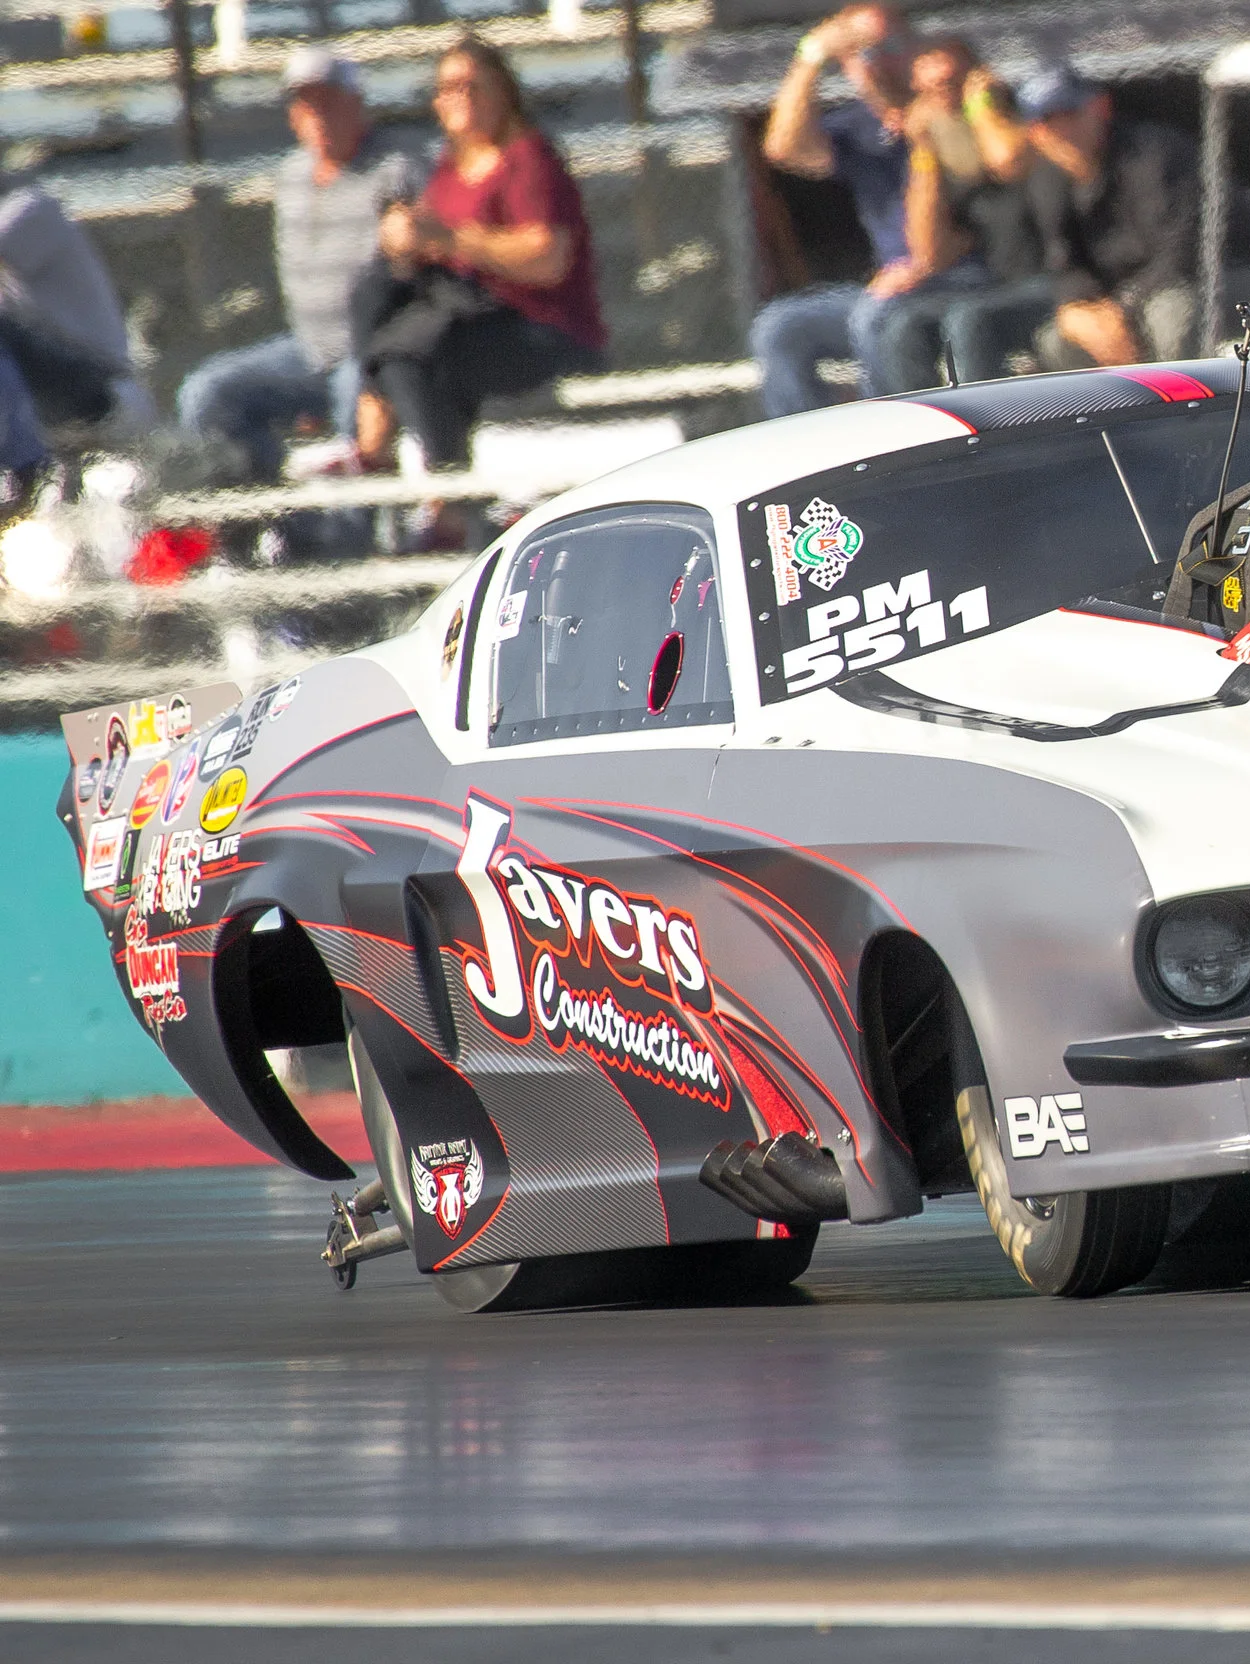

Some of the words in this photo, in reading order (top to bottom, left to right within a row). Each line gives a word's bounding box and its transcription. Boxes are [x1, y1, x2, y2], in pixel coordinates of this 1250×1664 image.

[775, 505, 798, 600] 800-222-4004
[782, 585, 990, 694] 5511
[806, 568, 932, 642] PM
[202, 834, 241, 861] ELITE
[465, 797, 706, 1018] Javers
[128, 945, 178, 988] DUNCAN
[533, 954, 719, 1090] Construction
[1004, 1092, 1090, 1158] BAE
